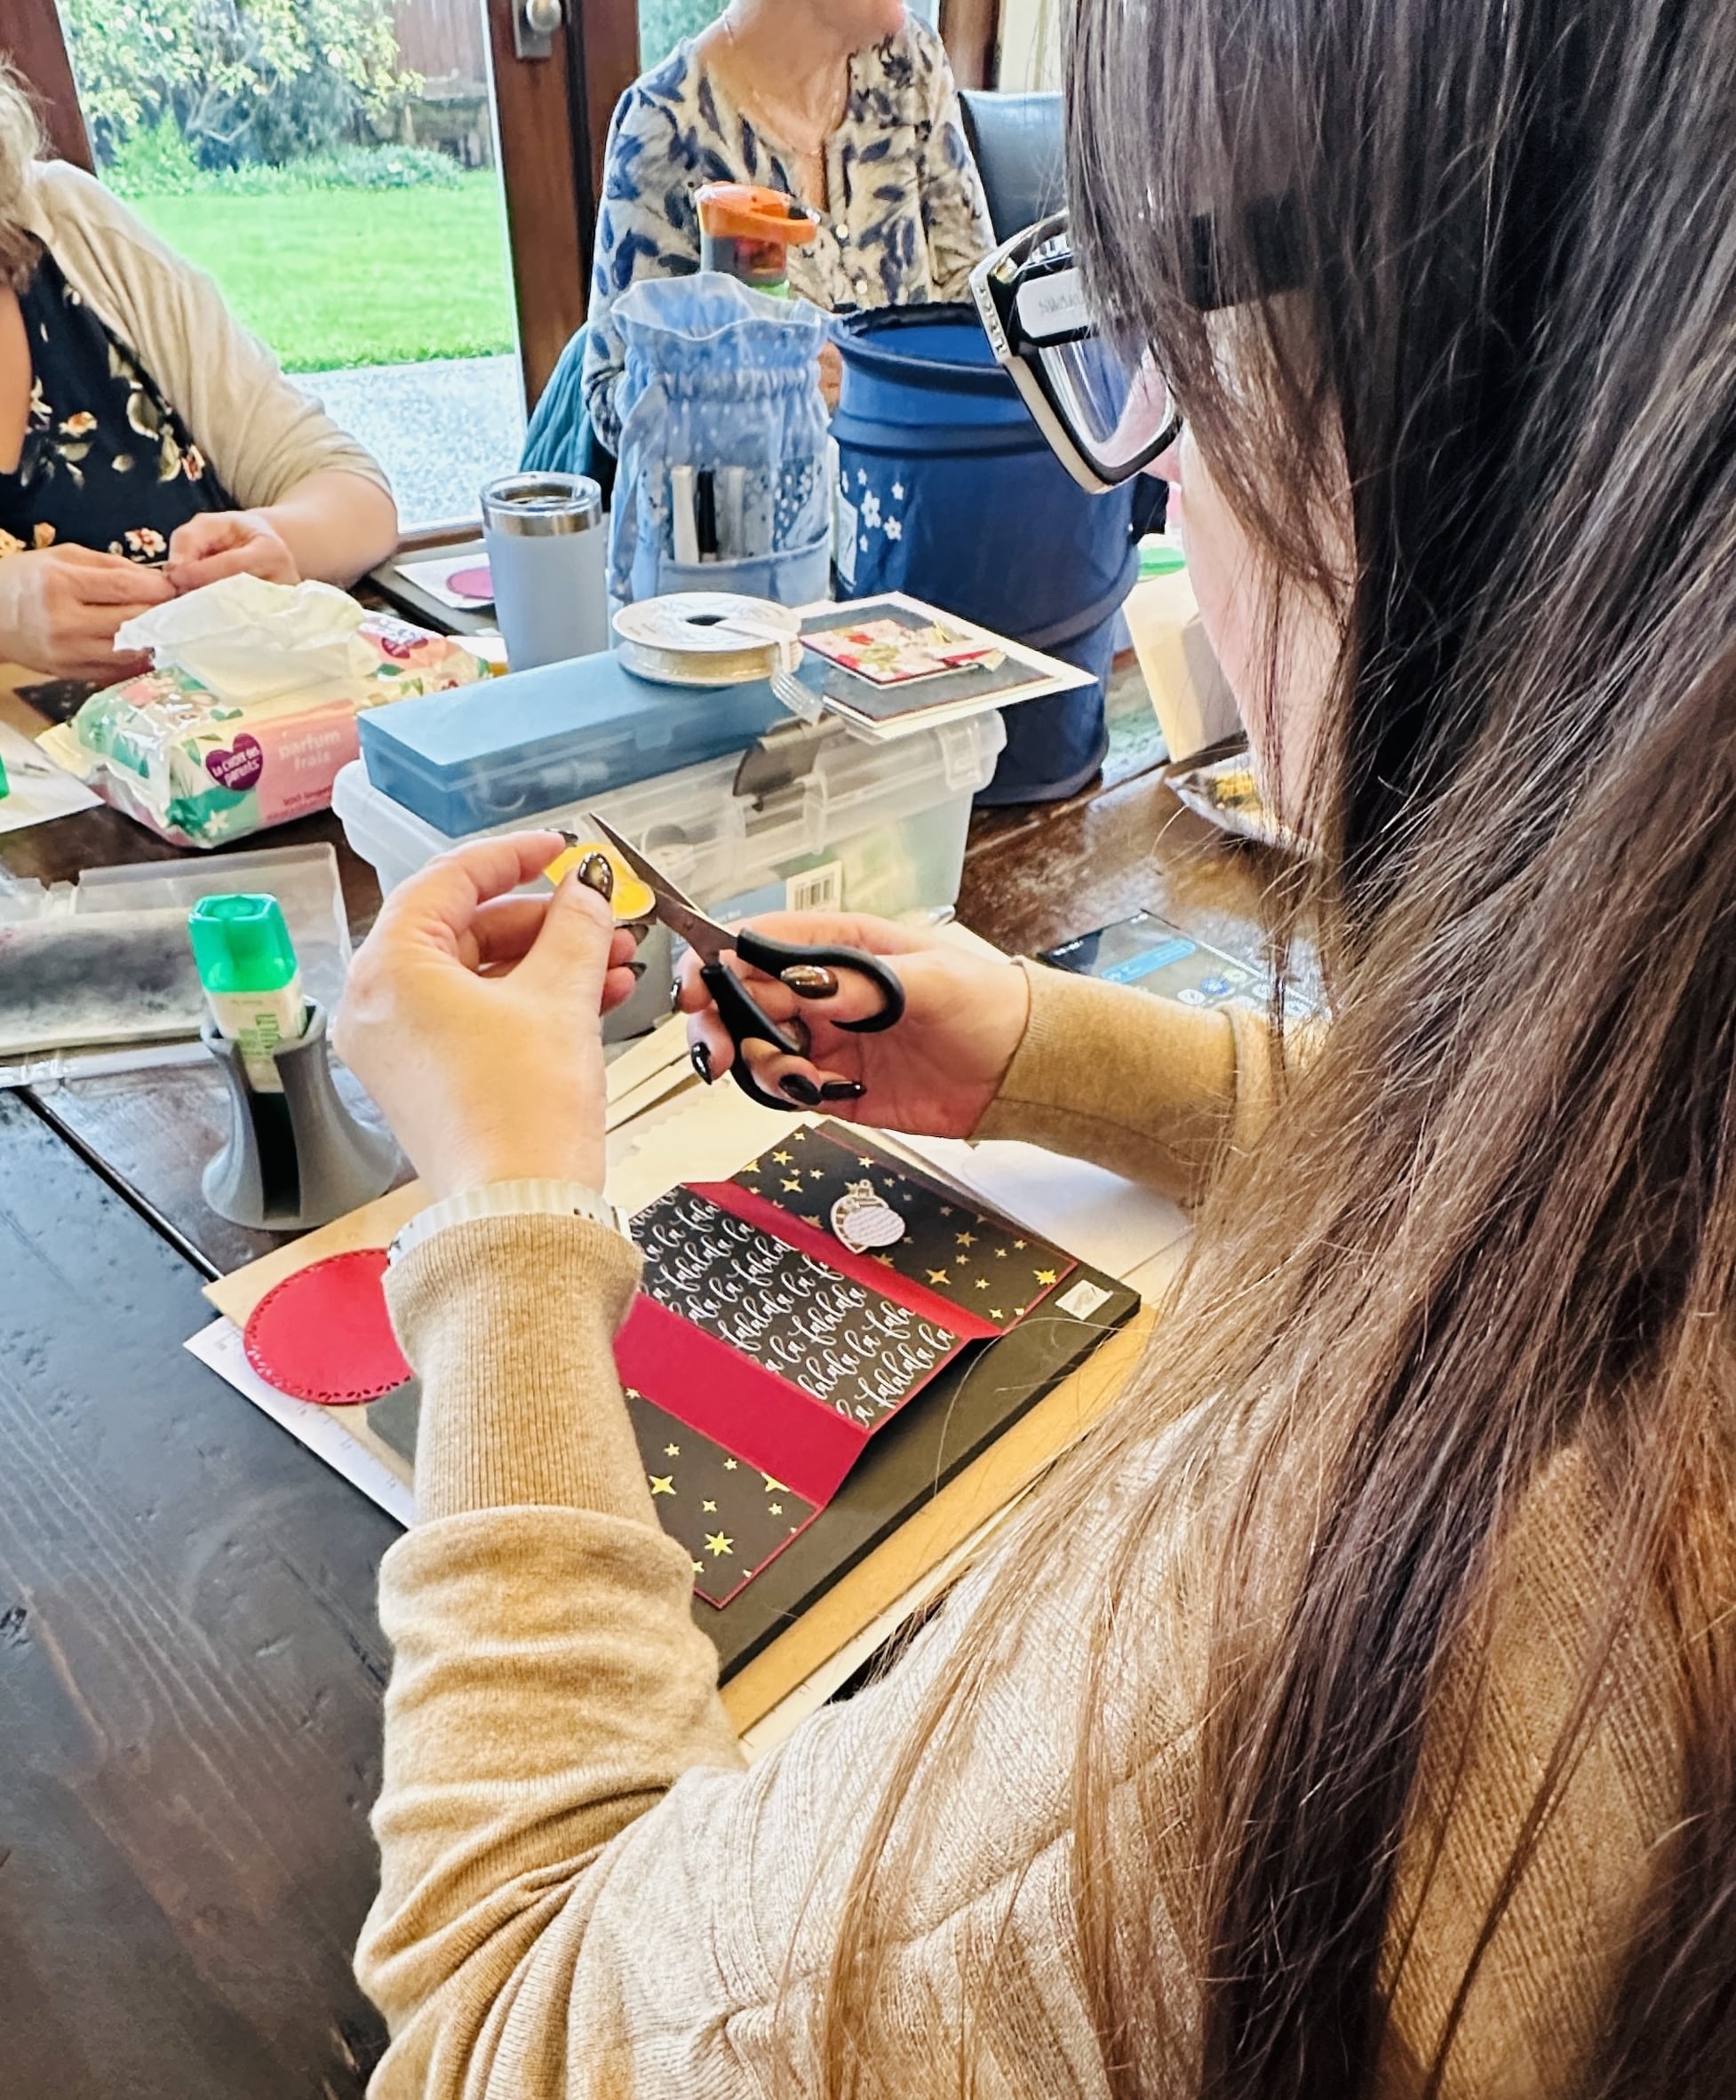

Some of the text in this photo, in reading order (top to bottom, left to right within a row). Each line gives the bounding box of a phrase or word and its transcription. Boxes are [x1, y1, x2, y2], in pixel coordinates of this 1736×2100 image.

[278, 730, 340, 761] parfum
[652, 1223, 686, 1247] la
[653, 1235, 735, 1292] falalala
[721, 1218, 755, 1242] la
[709, 1277, 744, 1302] la
[717, 1288, 795, 1351] falalala
[780, 1272, 816, 1297] la
[787, 1284, 867, 1346] falalala
[769, 1335, 807, 1363] la
[844, 1330, 881, 1357] la
[853, 1341, 935, 1409] falalala
[918, 1323, 955, 1351] la
